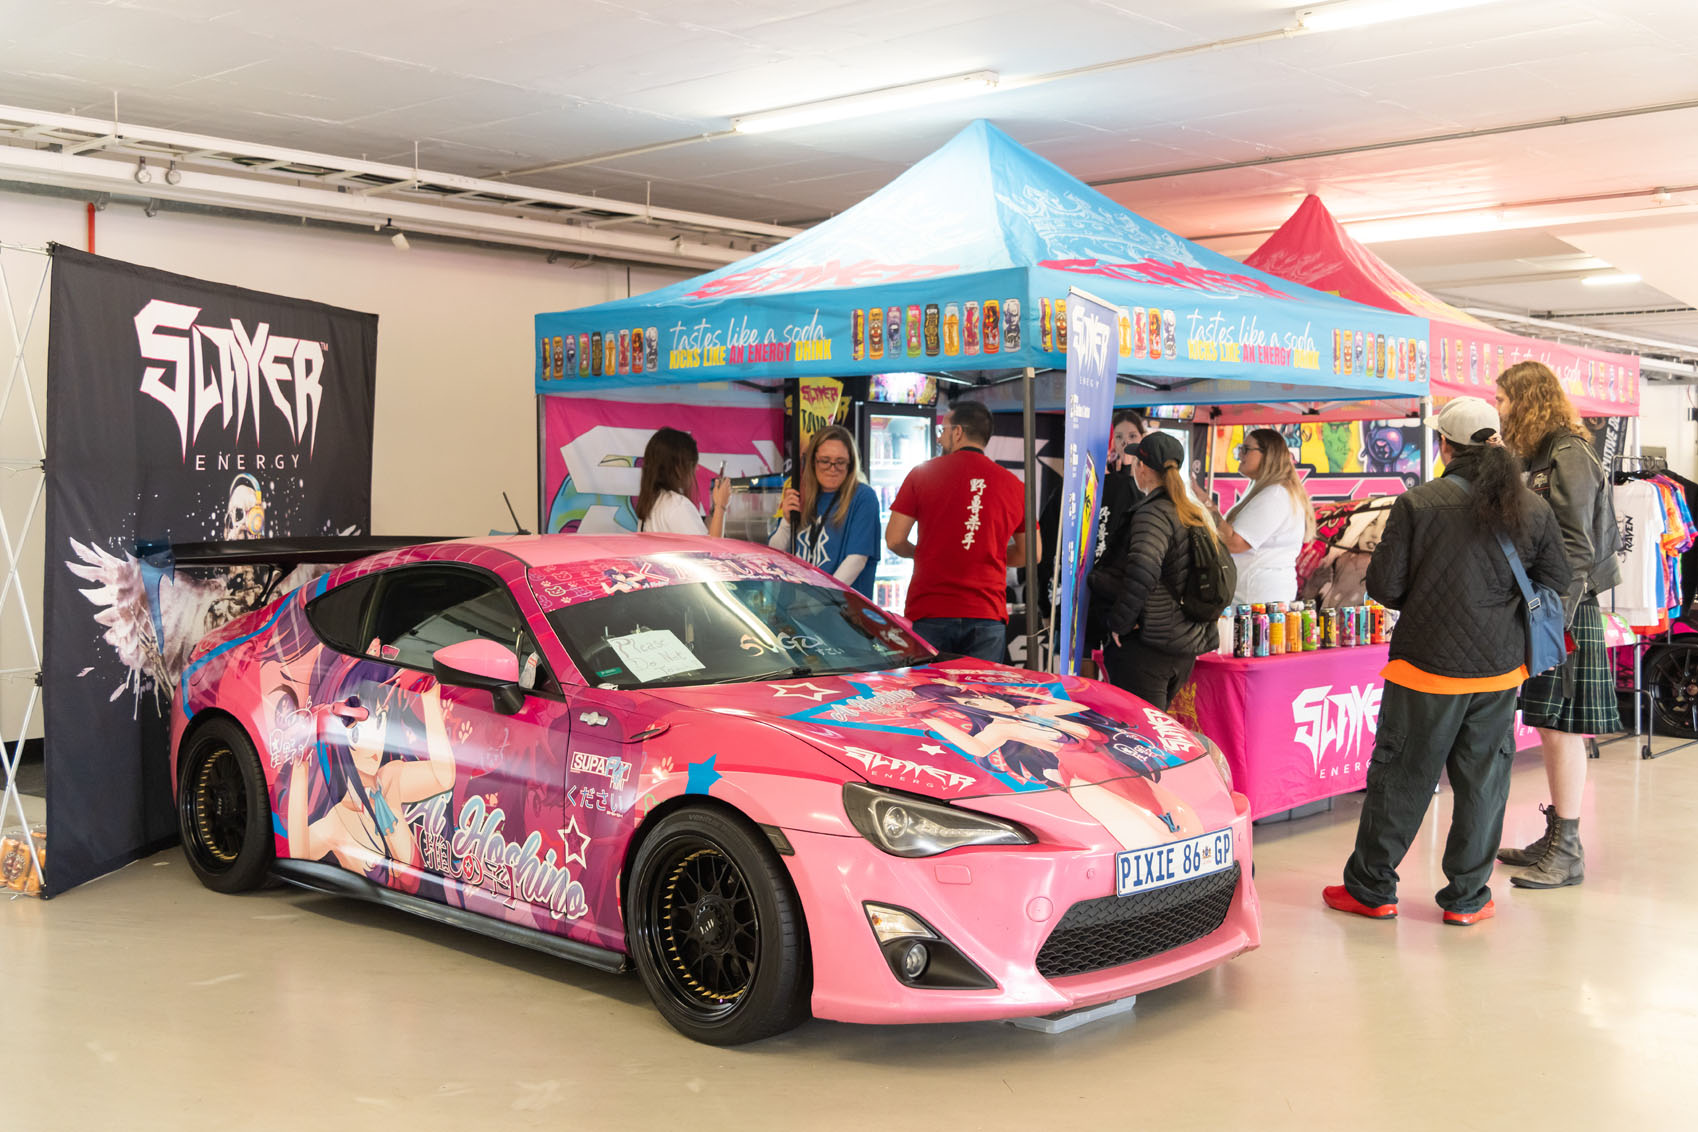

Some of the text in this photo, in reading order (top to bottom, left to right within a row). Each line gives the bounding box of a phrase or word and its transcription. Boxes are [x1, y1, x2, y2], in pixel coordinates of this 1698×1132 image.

[669, 308, 826, 354] tastes like a soda
[1186, 308, 1316, 352] tastes like a soda
[669, 338, 832, 370] KICKS LIKE AN ENERGY DRINK
[1187, 339, 1321, 370] KICKS LIKE AN ENERGY DRINK
[133, 298, 325, 464] SLAYER
[195, 453, 299, 471] ENERGY
[1624, 515, 1634, 553] RAVEN
[1291, 683, 1384, 776] SLAYE
[844, 745, 976, 792] SLAYER
[871, 770, 949, 792] ENERGY
[1319, 760, 1372, 779] ENERG
[566, 784, 624, 812] ください
[452, 795, 588, 920] Hoshino
[1120, 833, 1231, 889] PIXIE 86 GP
